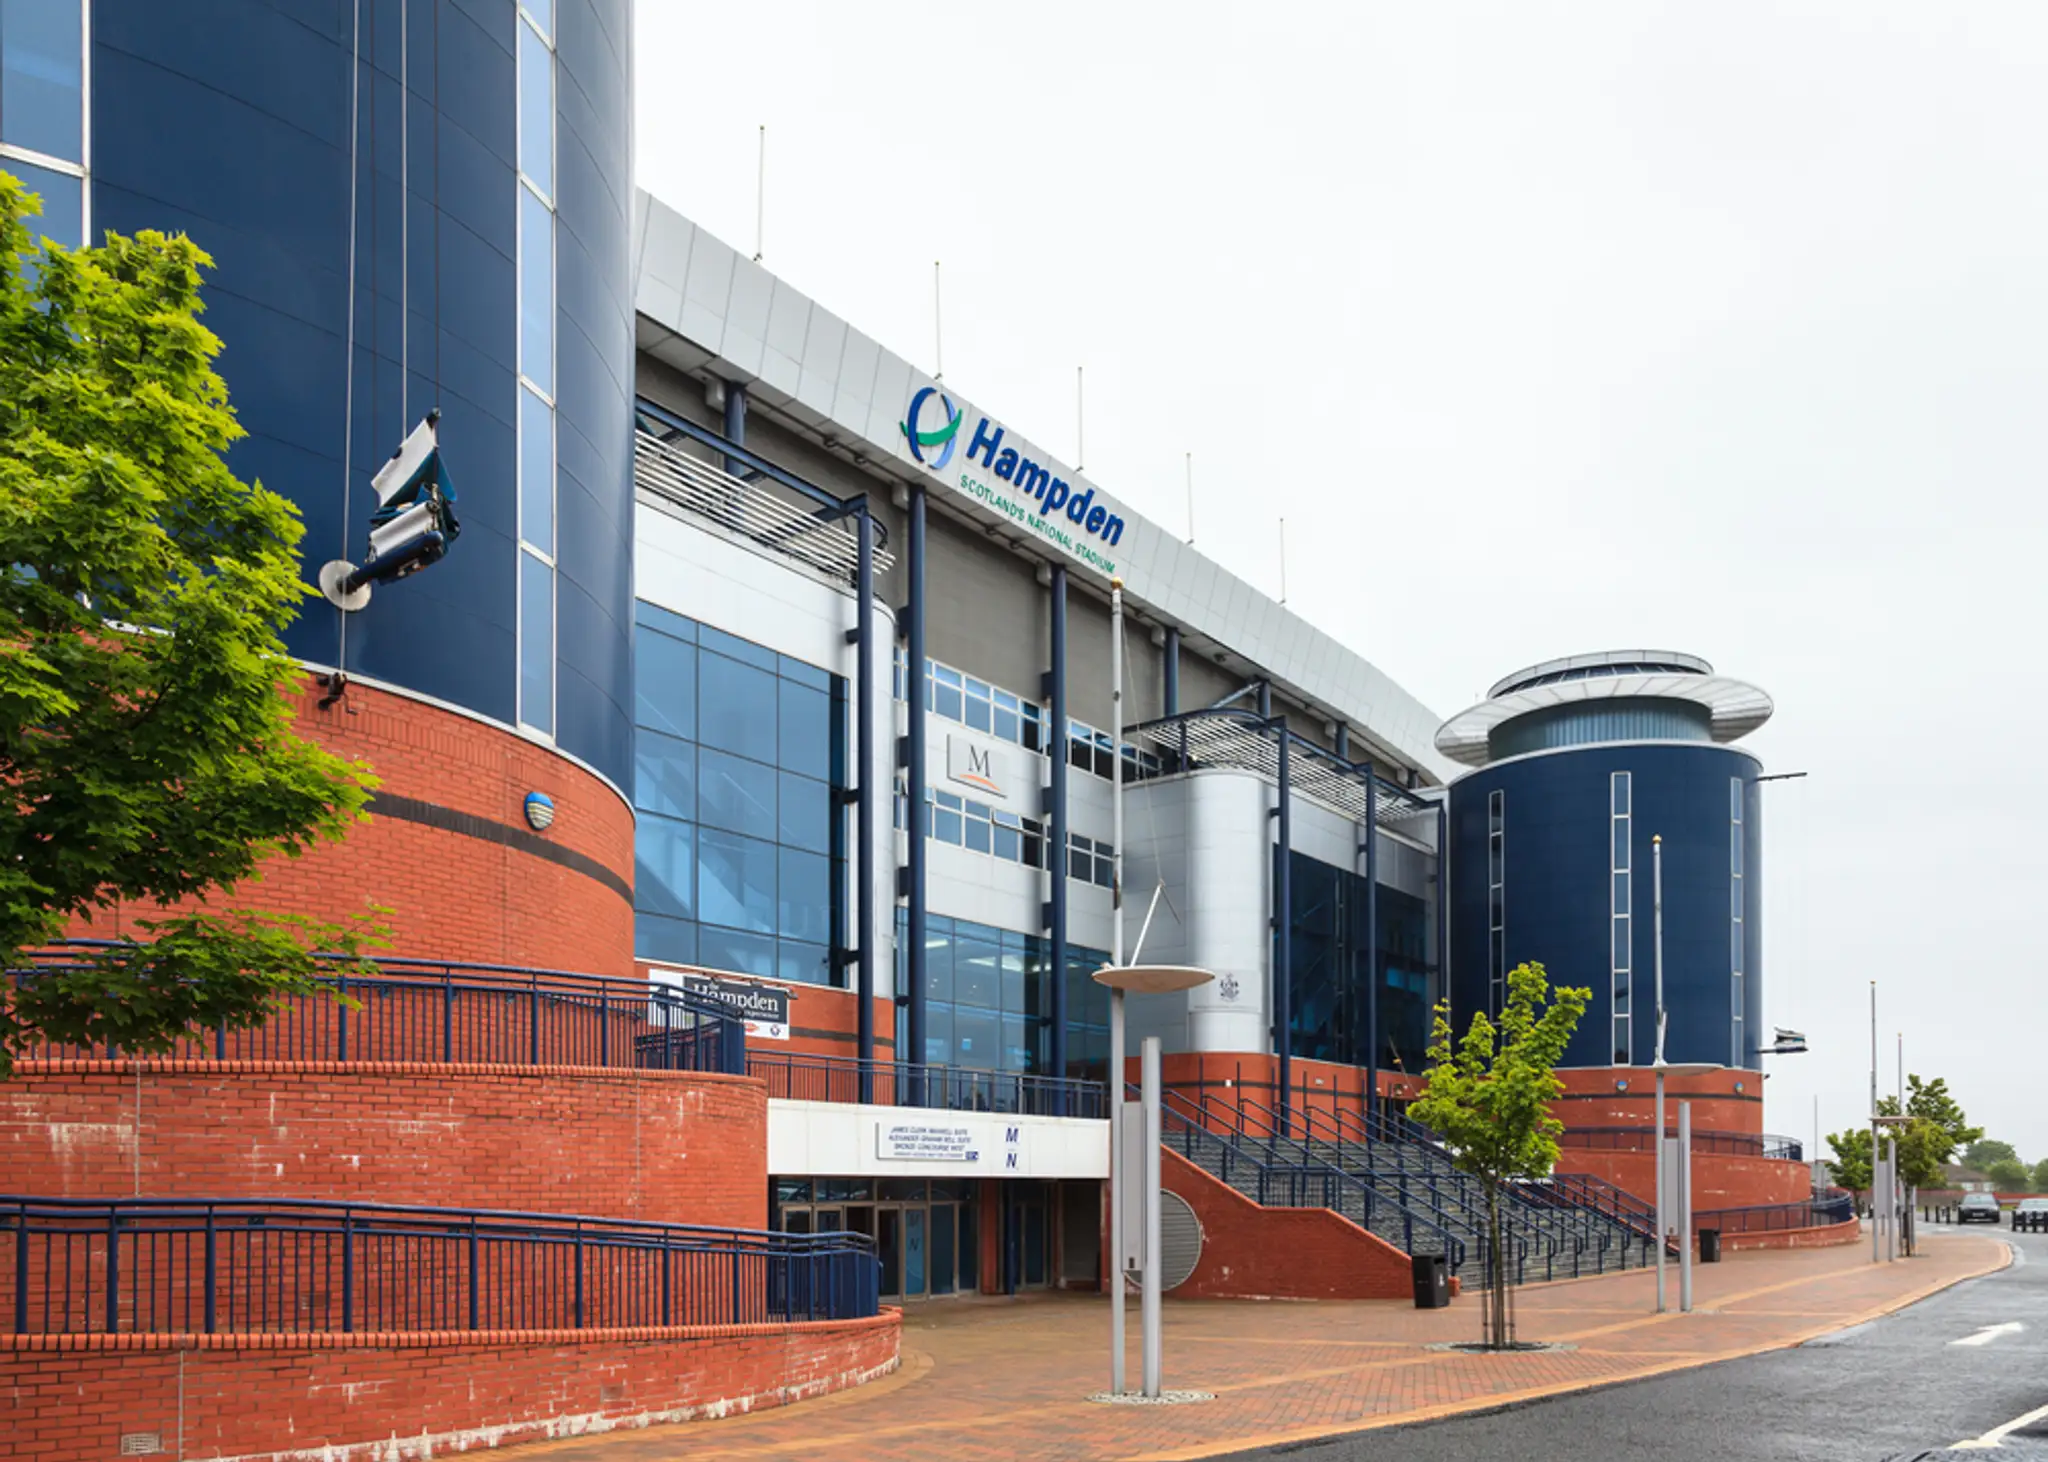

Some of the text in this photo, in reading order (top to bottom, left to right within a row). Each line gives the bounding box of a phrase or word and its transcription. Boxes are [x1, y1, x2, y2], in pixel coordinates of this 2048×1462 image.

[965, 417, 1125, 546] Hampden
[960, 474, 1116, 573] SCOTLAND'S NATIONAL STADIUM
[968, 744, 991, 778] M
[1006, 1127, 1018, 1142] M
[1006, 1153, 1017, 1168] N
